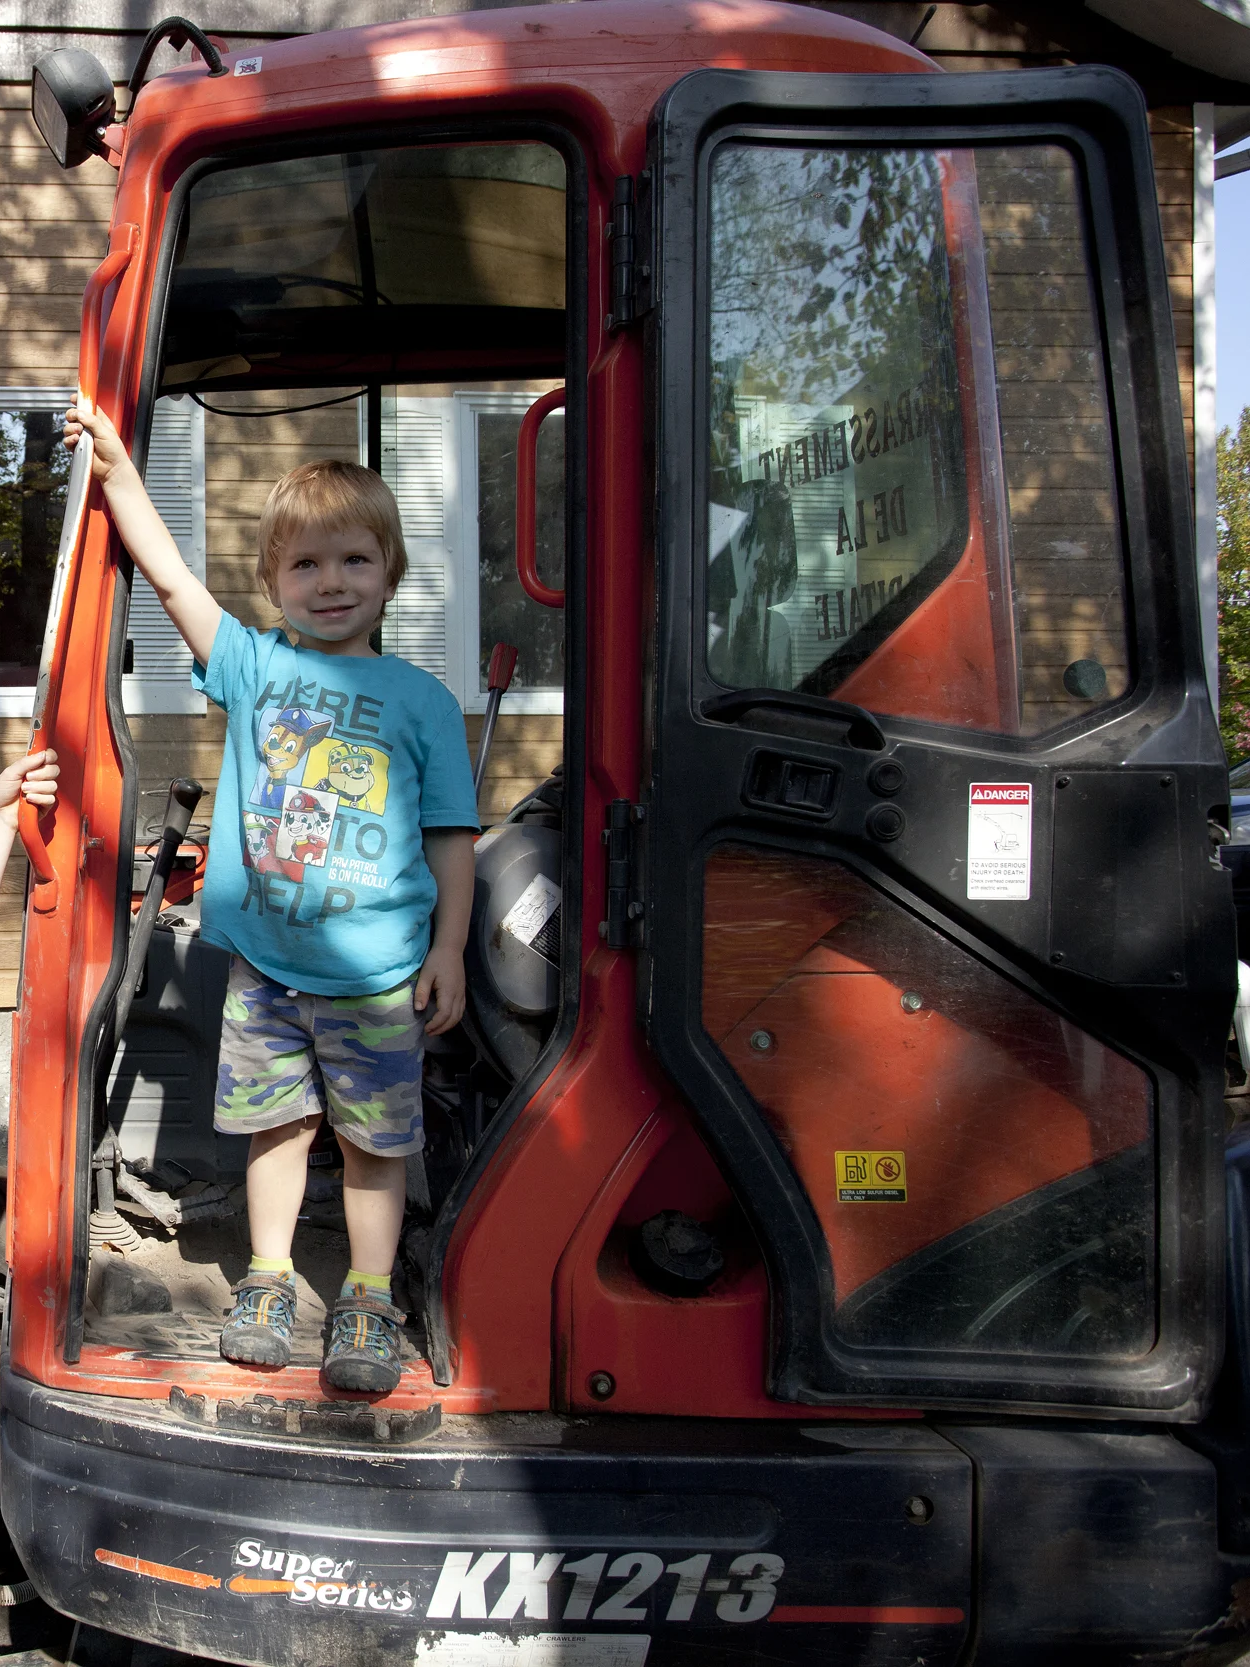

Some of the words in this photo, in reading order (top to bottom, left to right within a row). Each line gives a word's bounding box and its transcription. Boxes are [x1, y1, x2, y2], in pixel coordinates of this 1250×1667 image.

[254, 675, 384, 734] HERE
[984, 790, 1028, 800] DANGER
[332, 812, 388, 860] TO
[328, 868, 337, 880] IS
[338, 869, 351, 882] ON
[352, 871, 360, 883] A
[361, 873, 388, 889] ROLL!
[331, 856, 349, 868] PAW
[349, 859, 379, 874] PATROL
[240, 870, 356, 928] HELP
[236, 1541, 354, 1580] Super
[290, 1576, 412, 1611] Series
[426, 1551, 785, 1623] KX121-3
